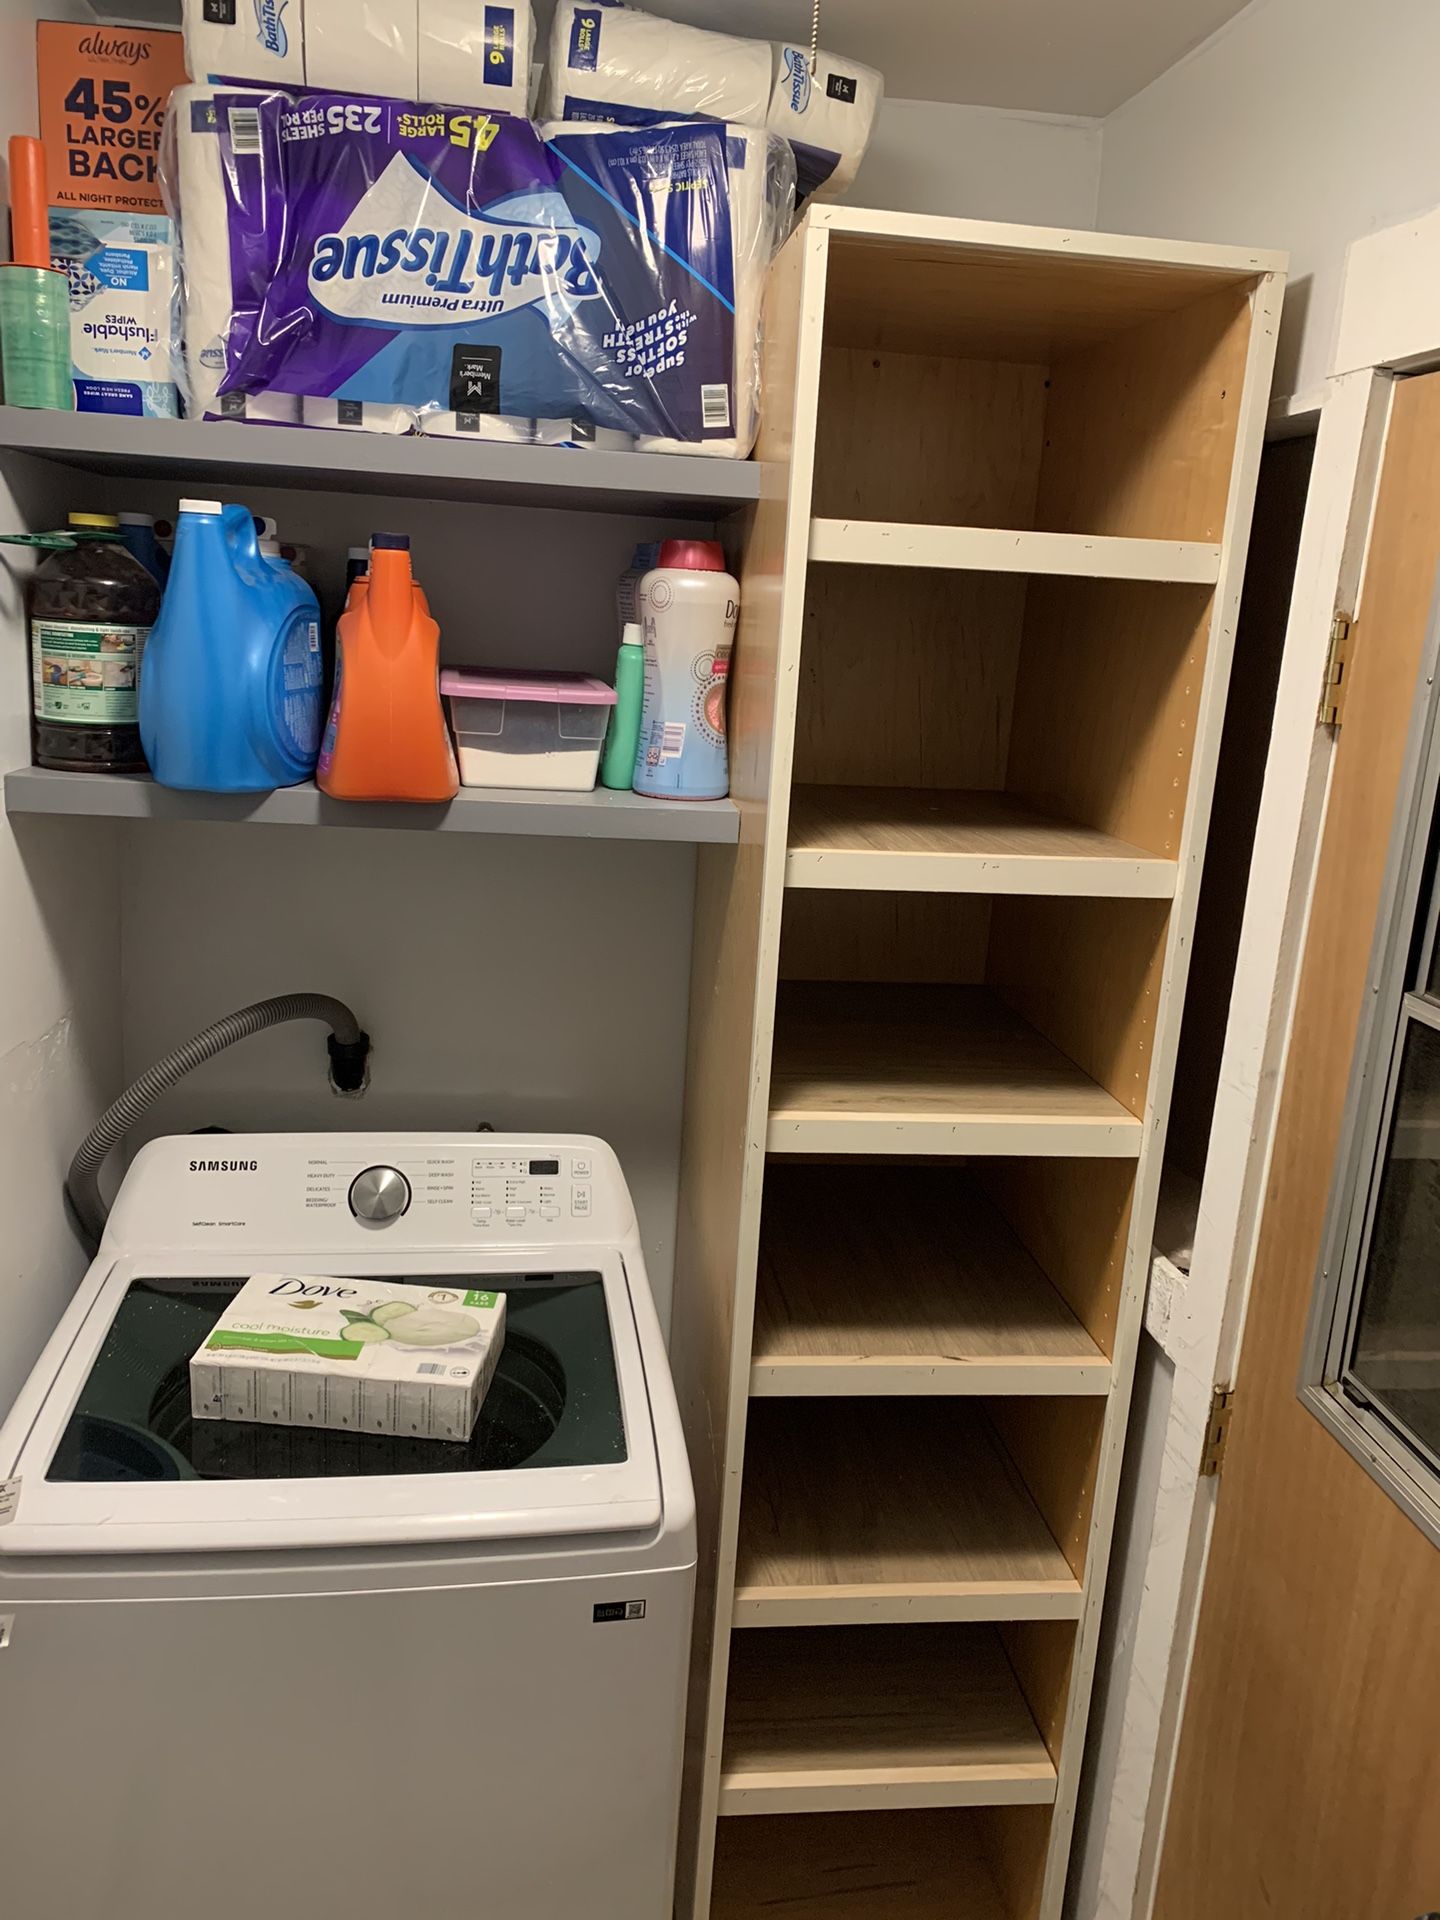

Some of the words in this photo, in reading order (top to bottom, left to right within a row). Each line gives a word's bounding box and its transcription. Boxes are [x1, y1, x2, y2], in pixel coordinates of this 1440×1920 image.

[581, 18, 596, 28] 9
[78, 31, 152, 66] always
[64, 78, 165, 128] 45%
[302, 109, 325, 124] PER
[327, 105, 382, 134] 235
[400, 124, 445, 138] LARGE
[450, 114, 500, 152] 45
[57, 192, 76, 201] ALL
[80, 193, 112, 204] NIGHT
[110, 278, 128, 286] NO
[382, 294, 458, 311] Premium
[462, 299, 504, 312] Ultra
[106, 314, 137, 325] WIPES
[648, 298, 678, 326] you
[675, 310, 690, 322] the
[676, 314, 698, 330] with
[84, 323, 158, 342] Flushable
[602, 320, 674, 350] STRETH
[460, 370, 491, 380] Member's
[190, 1160, 258, 1171] SAMSUNG
[268, 1278, 358, 1298] Dove
[232, 1322, 264, 1330] cool
[266, 1324, 330, 1336] moisture
